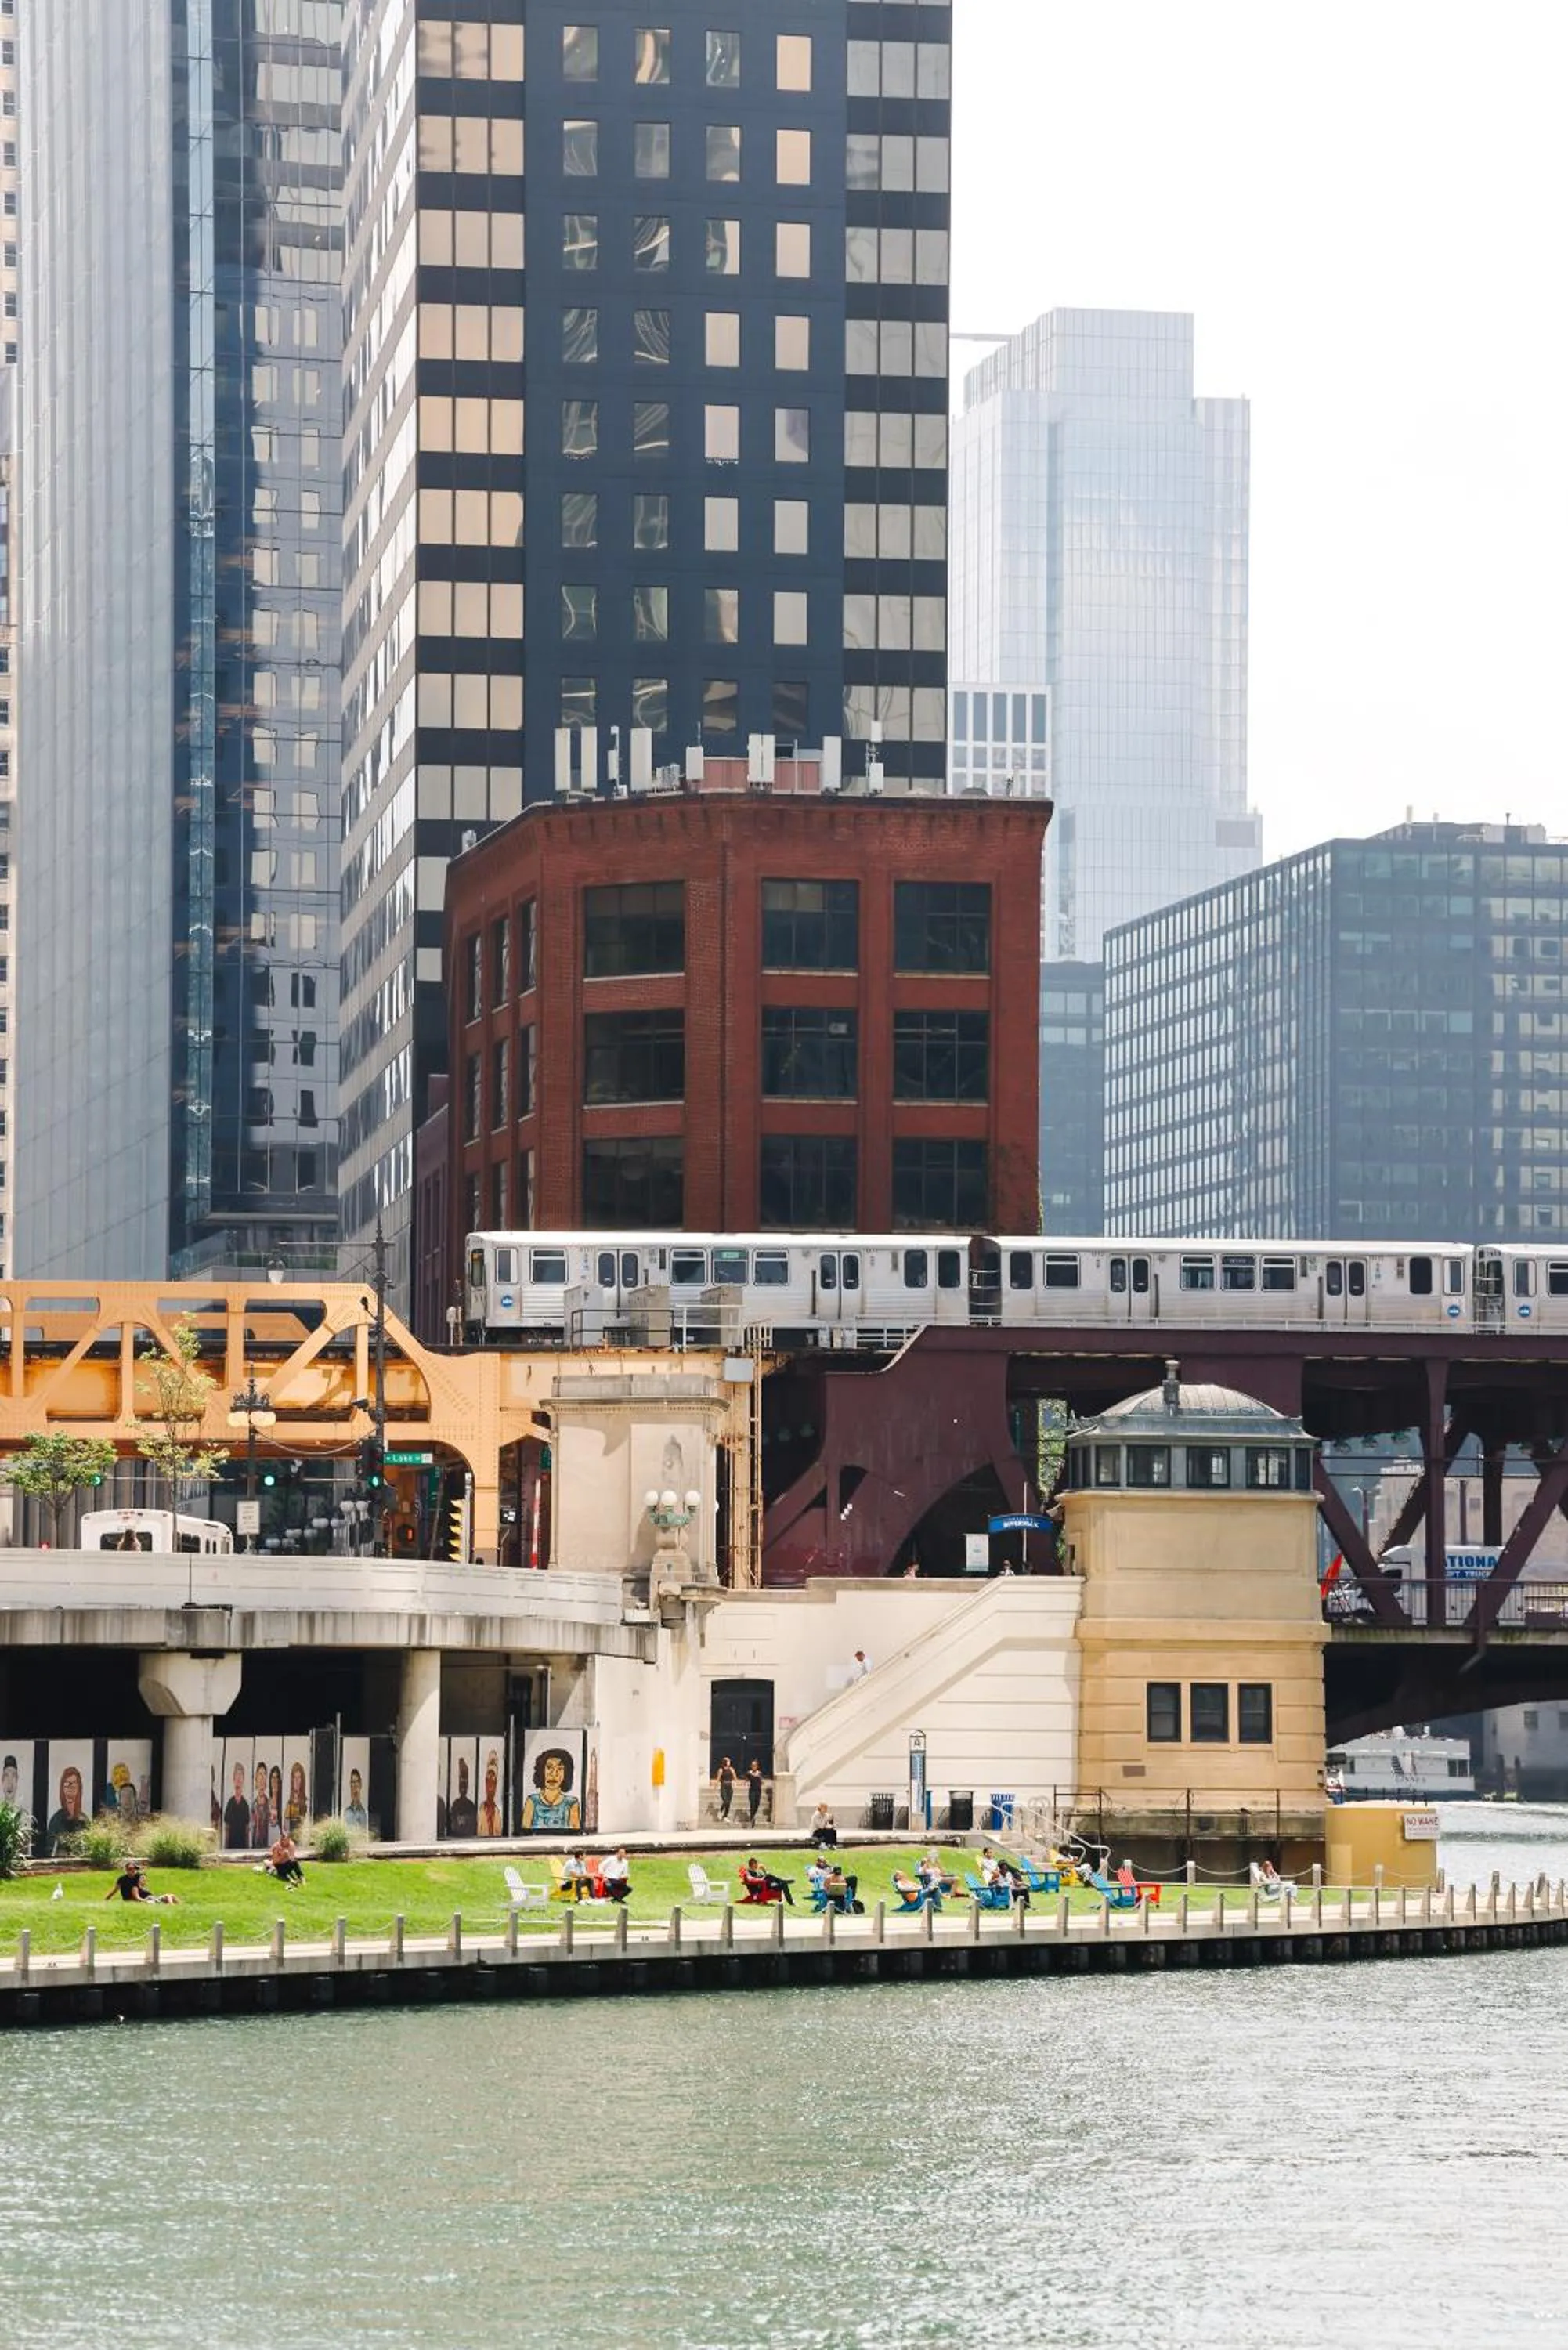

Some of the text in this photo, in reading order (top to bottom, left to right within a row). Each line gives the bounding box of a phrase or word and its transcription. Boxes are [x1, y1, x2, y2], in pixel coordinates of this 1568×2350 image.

[1444, 1555, 1498, 1567] TIONA
[1406, 1817, 1439, 1825] NO WAKE
